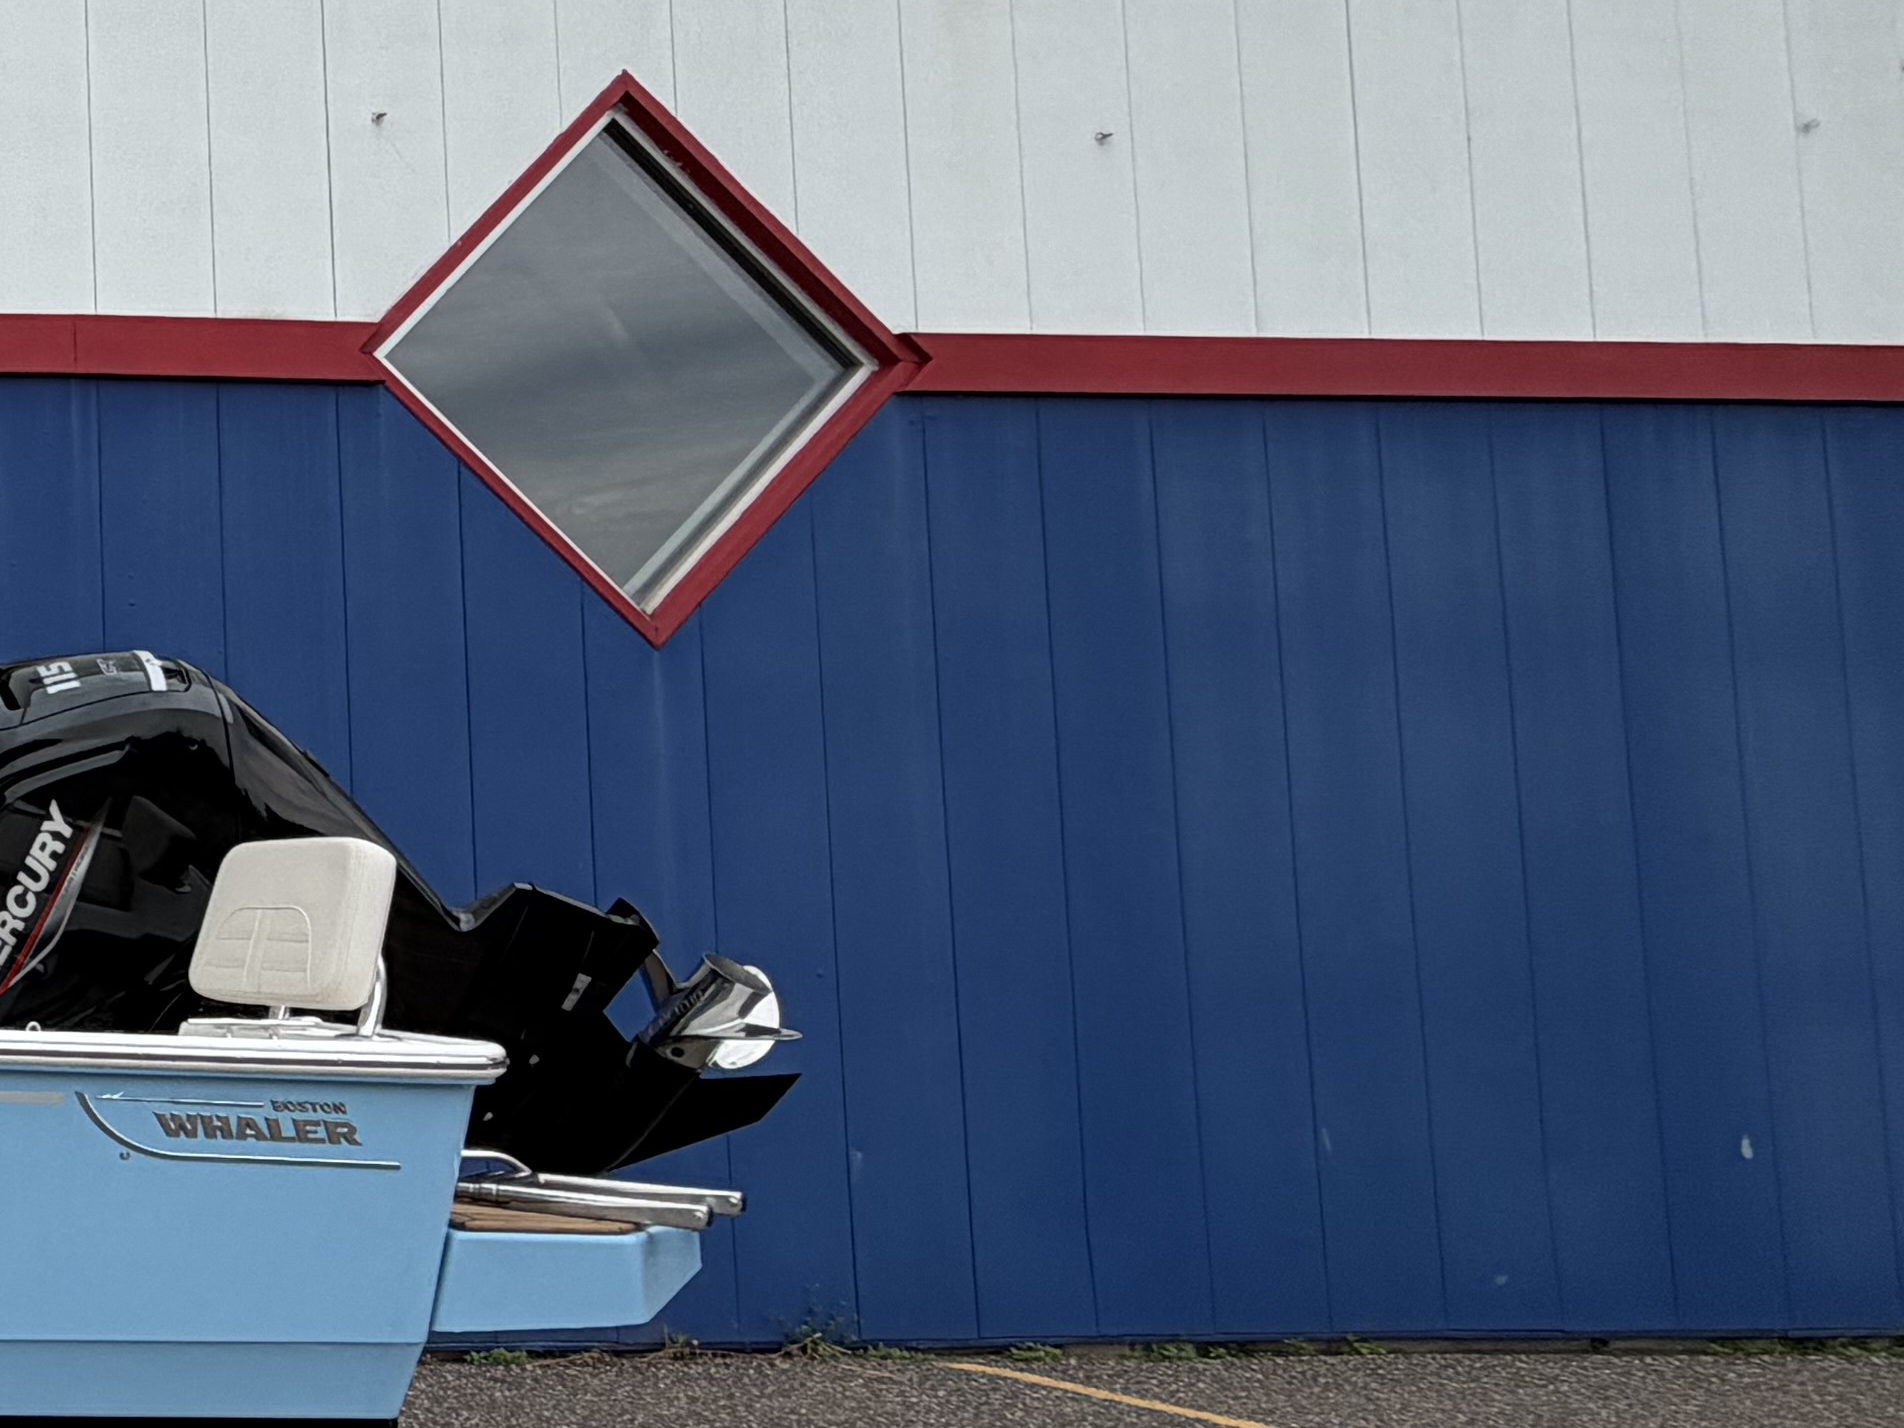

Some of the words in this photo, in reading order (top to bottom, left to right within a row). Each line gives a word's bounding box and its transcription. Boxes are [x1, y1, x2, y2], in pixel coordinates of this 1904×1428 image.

[36, 661, 82, 694] 115
[269, 1099, 347, 1115] BOSTON
[153, 1111, 363, 1147] WHALER
